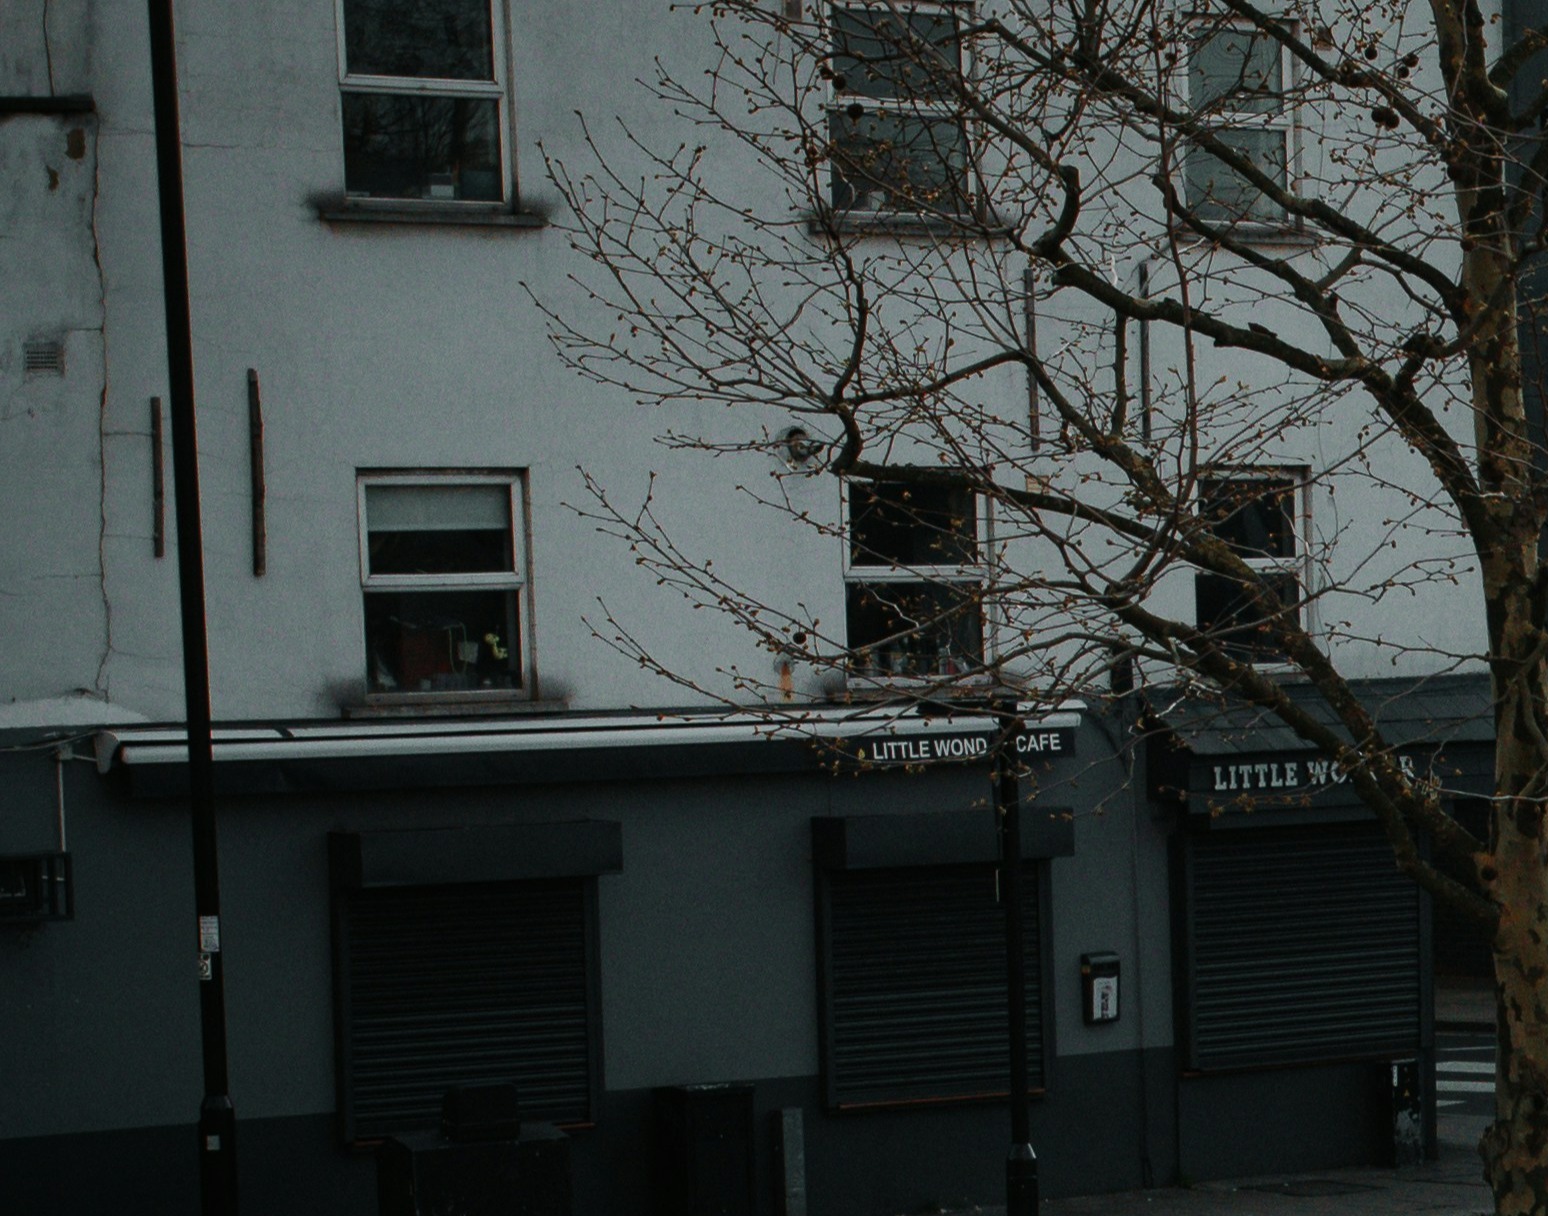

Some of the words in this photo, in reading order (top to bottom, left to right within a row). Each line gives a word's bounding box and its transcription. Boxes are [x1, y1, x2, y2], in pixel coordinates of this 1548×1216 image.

[872, 740, 931, 760] LITTLE
[933, 736, 1006, 757] WOND
[1015, 733, 1062, 753] CAFE
[1213, 762, 1299, 791] LITTLE
